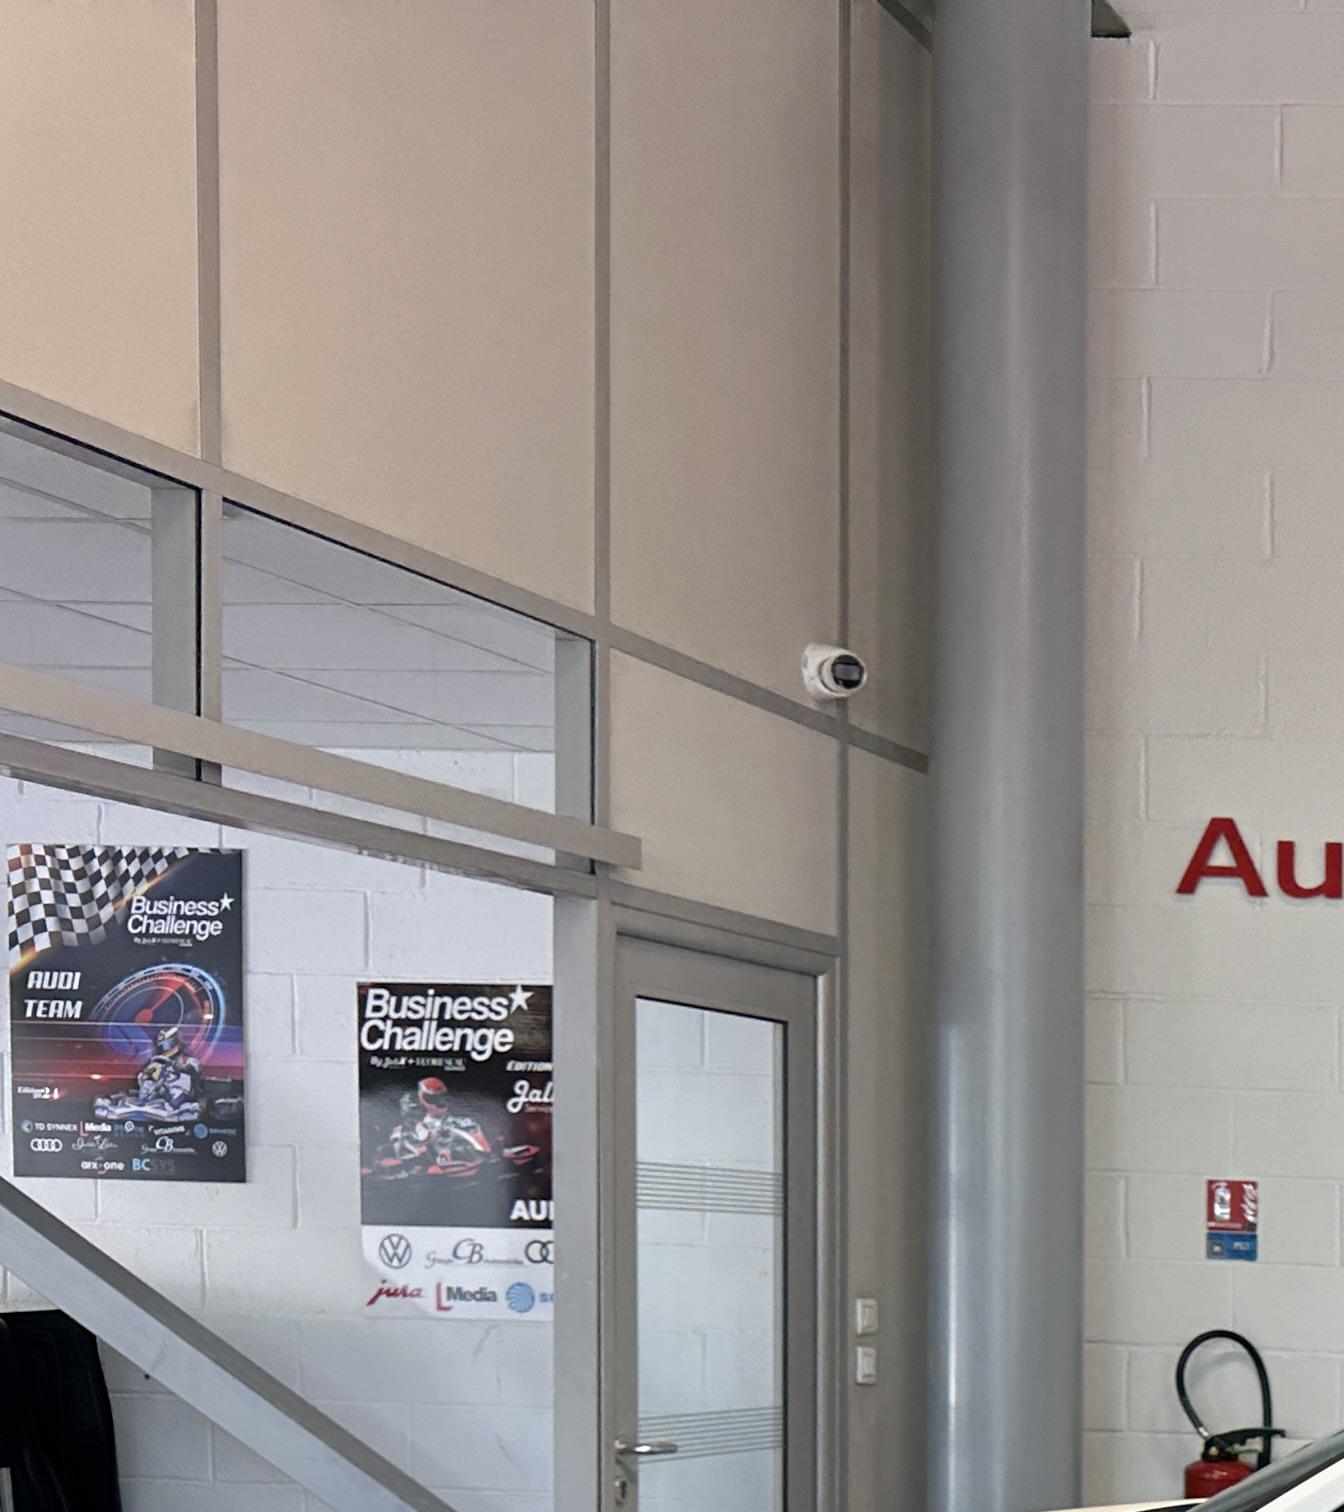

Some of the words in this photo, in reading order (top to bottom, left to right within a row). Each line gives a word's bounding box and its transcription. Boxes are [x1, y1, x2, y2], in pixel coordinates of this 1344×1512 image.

[131, 895, 219, 916] Business
[127, 914, 223, 941] Challenge
[27, 970, 81, 990] AUDI
[24, 999, 83, 1019] TEAM
[365, 988, 509, 1021] Business
[360, 1019, 515, 1062] Challenge
